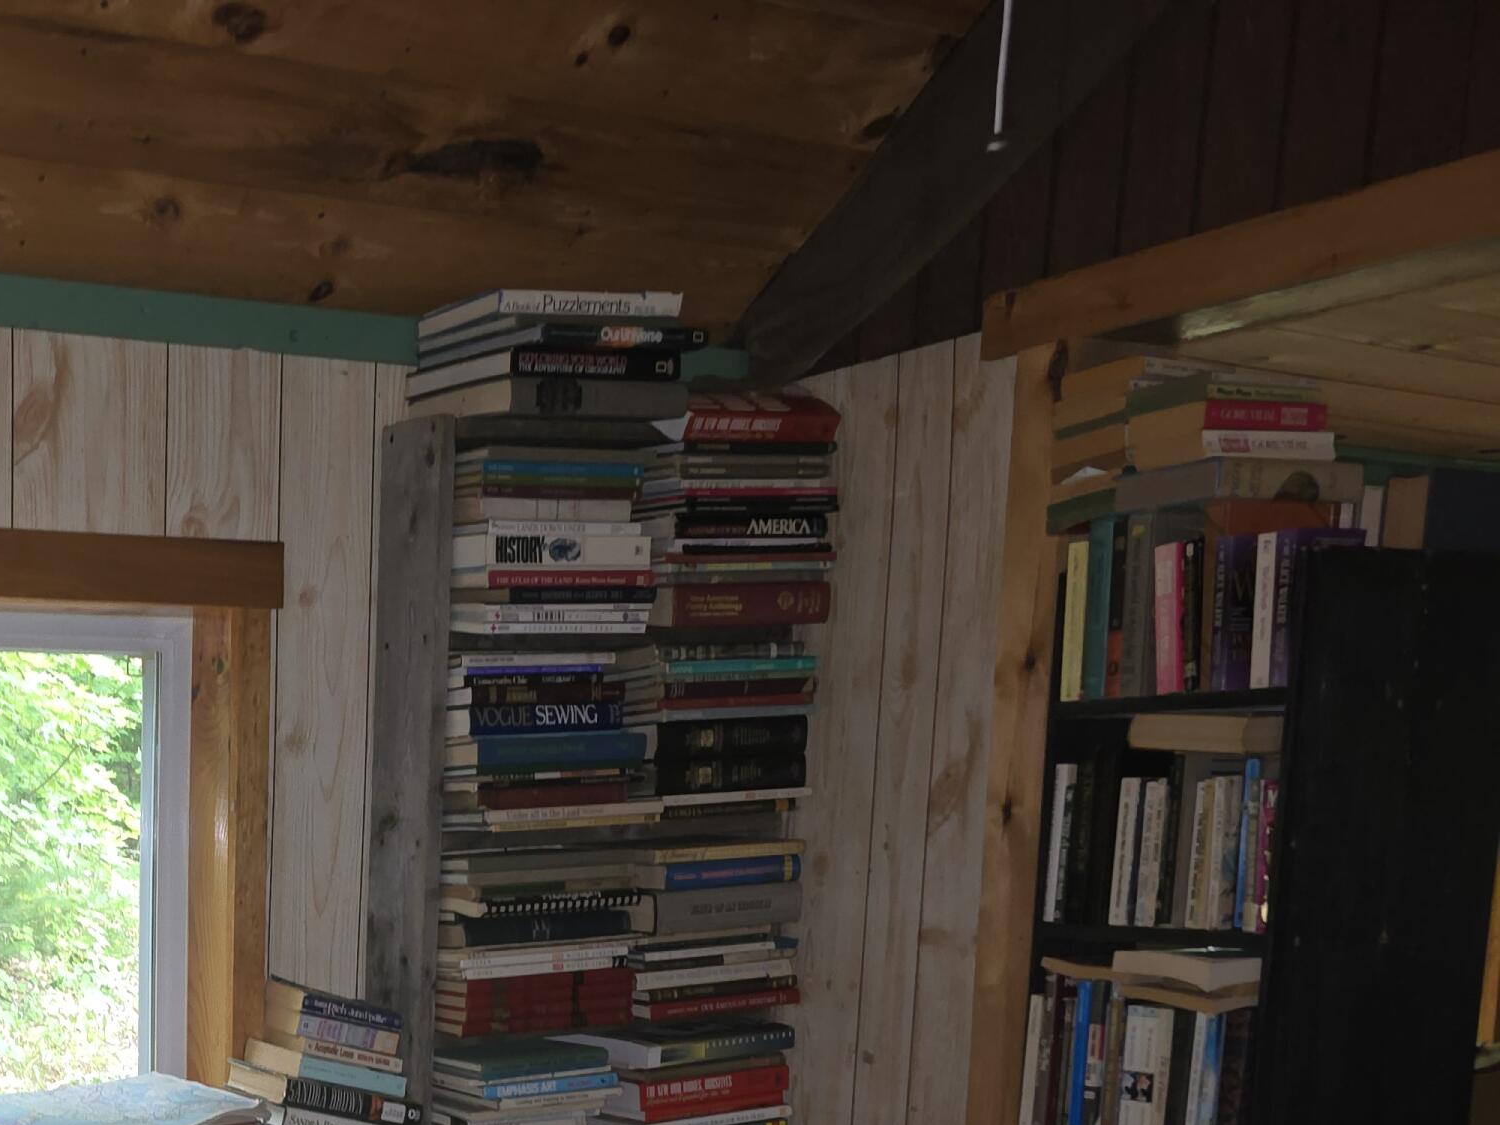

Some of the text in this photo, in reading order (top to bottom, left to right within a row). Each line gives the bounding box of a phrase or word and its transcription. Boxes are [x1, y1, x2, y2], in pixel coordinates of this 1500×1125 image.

[543, 294, 631, 316] Puzzlements
[518, 353, 628, 365] EXPLORING YOUR WORLD
[518, 363, 533, 372] THE
[534, 363, 573, 373] ADVENTURE
[585, 364, 627, 375] GEOGRAPHY
[746, 517, 811, 535] AMERICA
[495, 535, 546, 564] HISTORY
[475, 703, 599, 728] VOGUE SEWING
[288, 1077, 364, 1116] SANDRA BROWN
[496, 1079, 557, 1099] EMPHASIS ART
